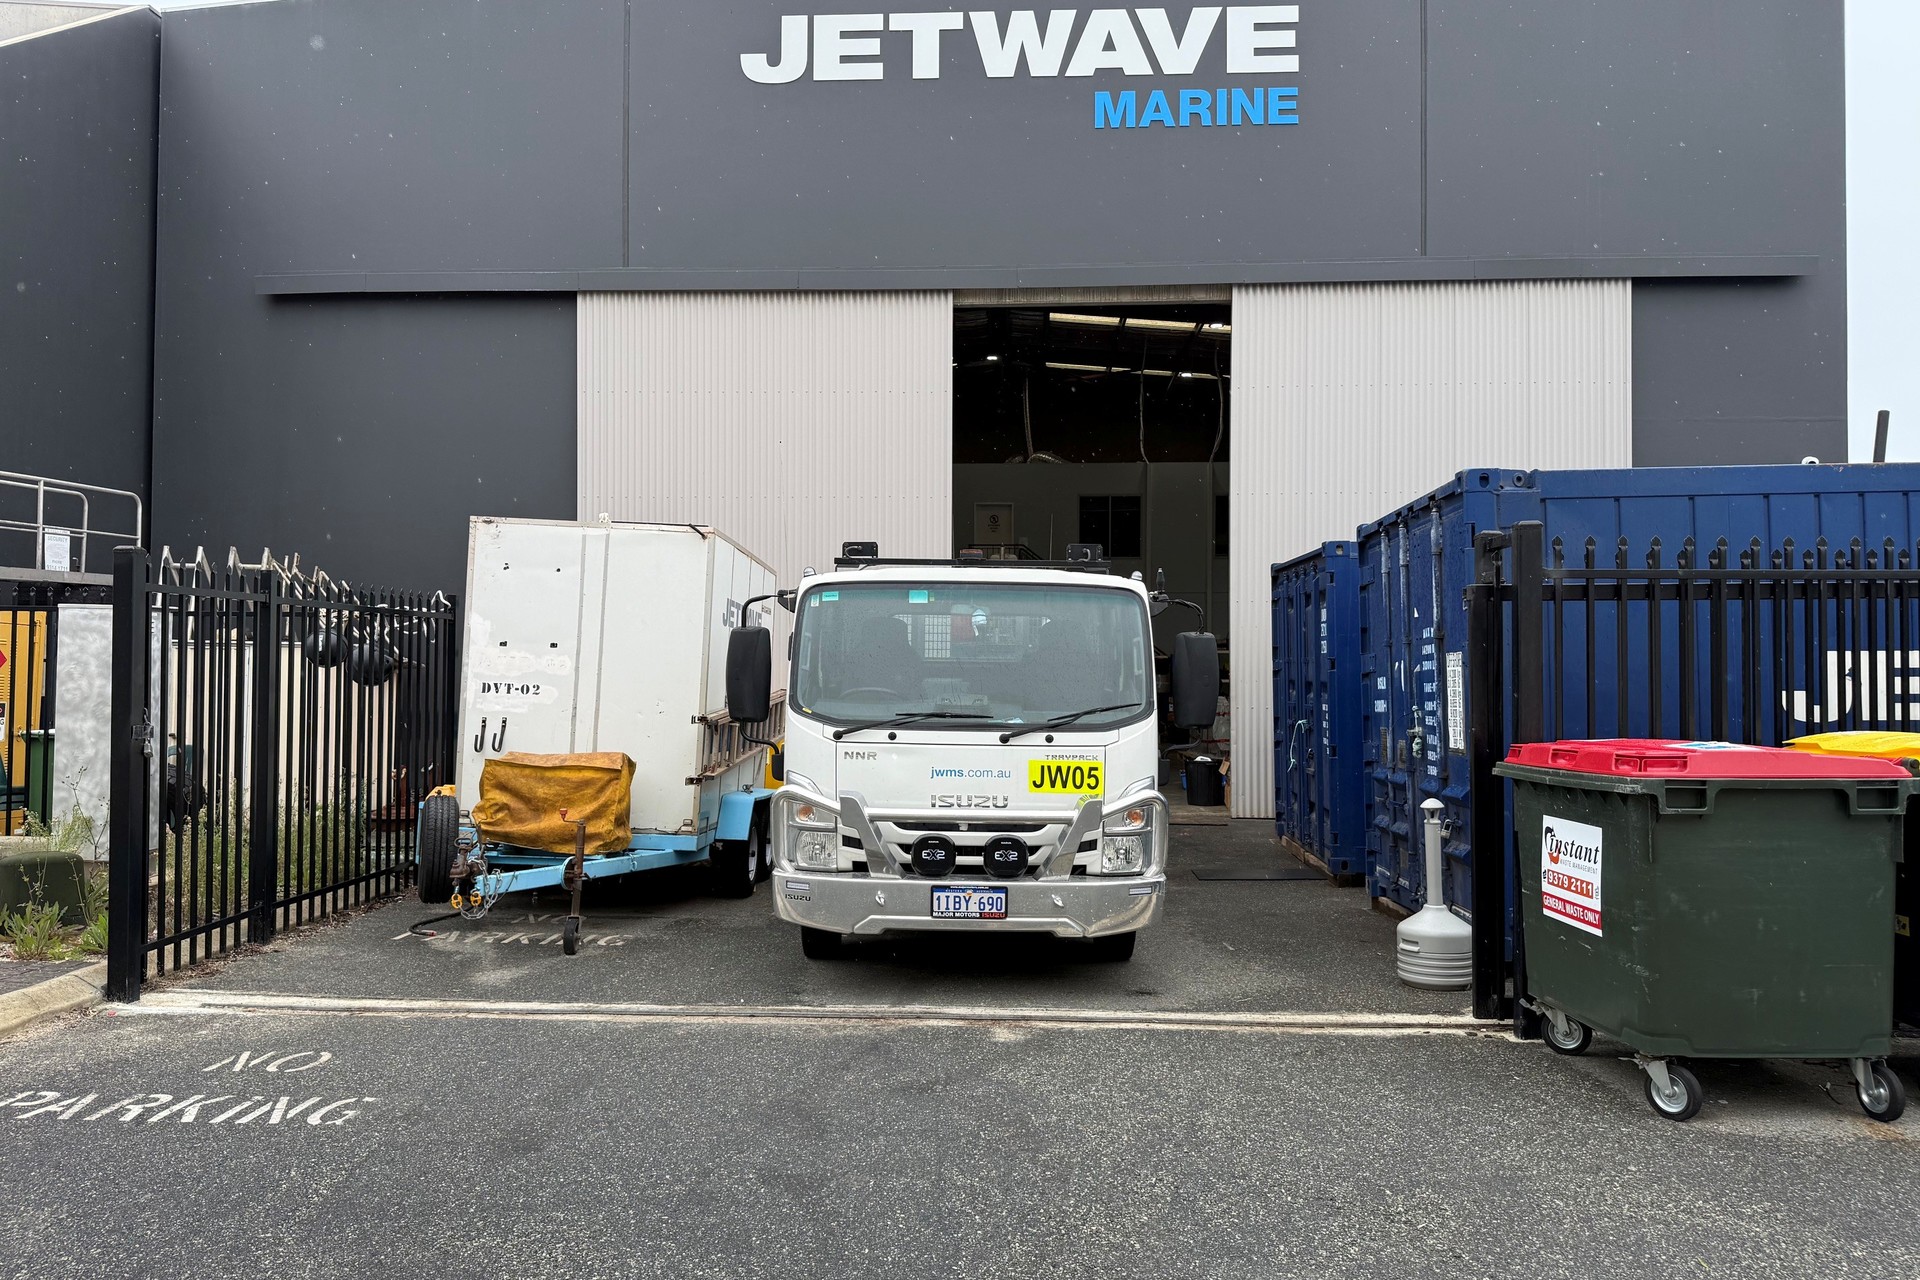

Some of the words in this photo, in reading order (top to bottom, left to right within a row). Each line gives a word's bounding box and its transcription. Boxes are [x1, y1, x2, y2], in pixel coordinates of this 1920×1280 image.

[740, 5, 1299, 83] JETWAVE
[1094, 87, 1299, 129] MARINE
[481, 682, 541, 695] DVT-02
[844, 751, 877, 760] NNR
[930, 767, 1011, 779] jwms.com.au
[1032, 765, 1099, 790] JW05
[931, 794, 1009, 808] ISUZU
[1549, 836, 1599, 864] instant
[1548, 871, 1569, 888] 9379
[1571, 878, 1592, 896] 2111
[785, 893, 811, 901] ISUZU
[1543, 895, 1565, 912] GENERAL
[1565, 903, 1584, 919] WASTE
[1584, 911, 1600, 925] ONLY
[202, 1051, 333, 1072] NO
[0, 1090, 377, 1125] PARKING
